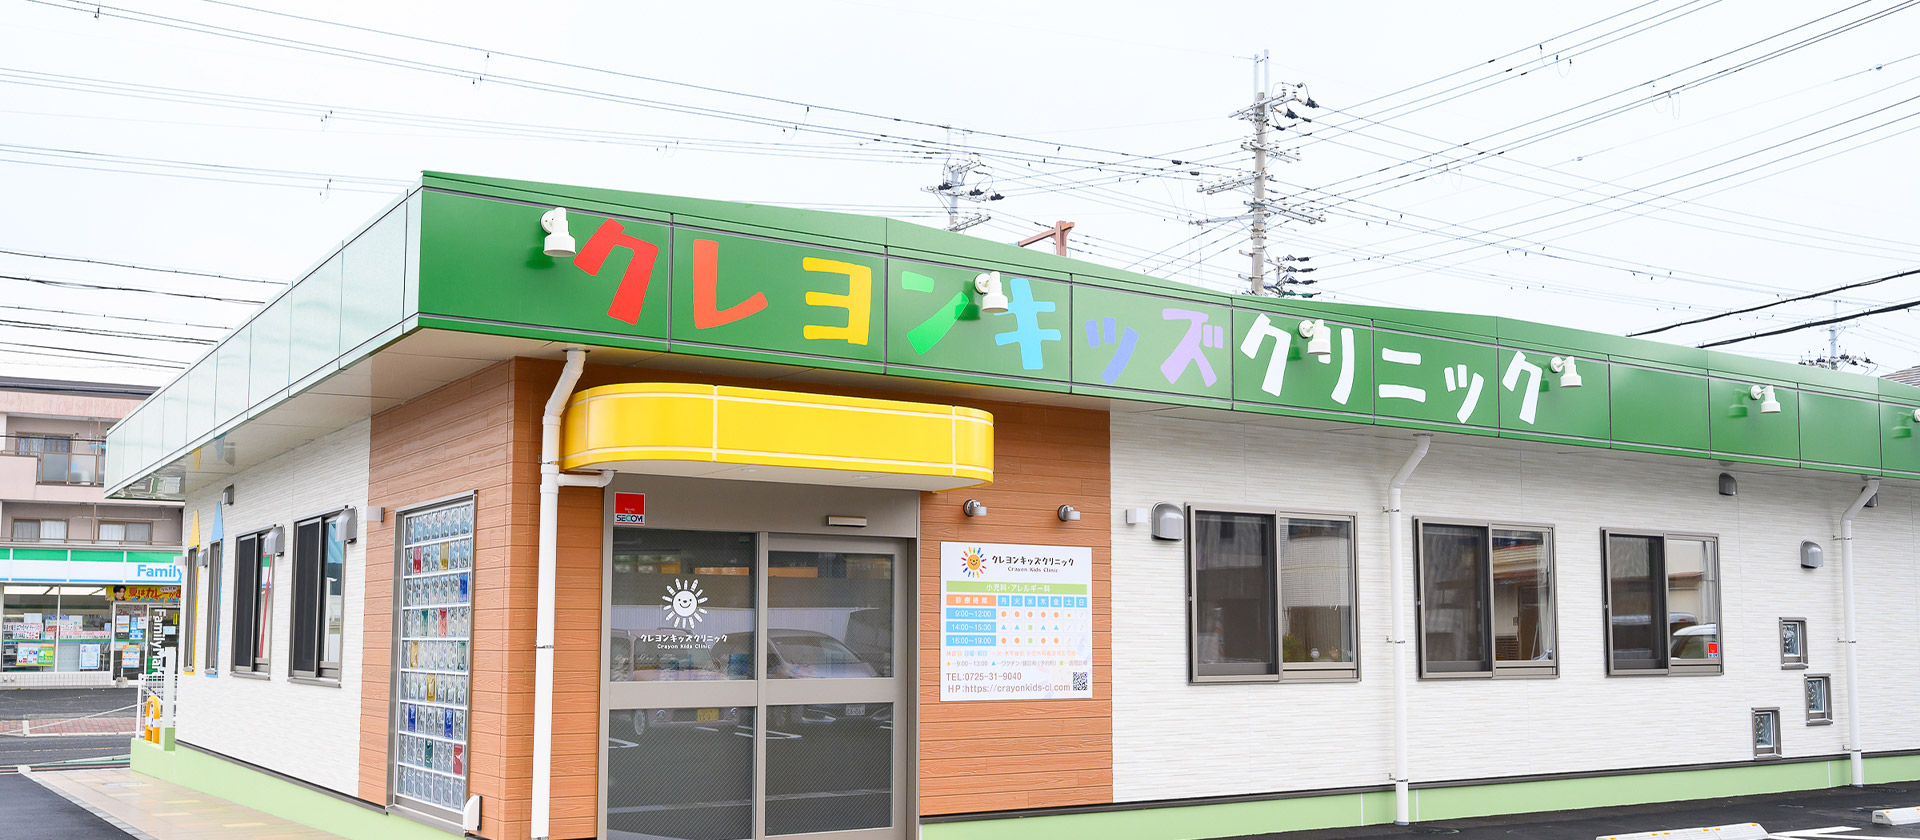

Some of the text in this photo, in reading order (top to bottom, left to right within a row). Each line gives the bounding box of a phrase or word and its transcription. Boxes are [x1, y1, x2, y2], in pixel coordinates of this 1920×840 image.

[573, 217, 1543, 425] クレヨンキッズクリニック
[616, 514, 643, 522] SECOM
[992, 555, 1074, 566] クレヨンキッズクリニック
[986, 584, 1050, 593] 小児科・アレルギー科
[640, 634, 728, 642] クレヨンキッズクリニック
[946, 672, 1022, 681] TEL:0725-31-9040
